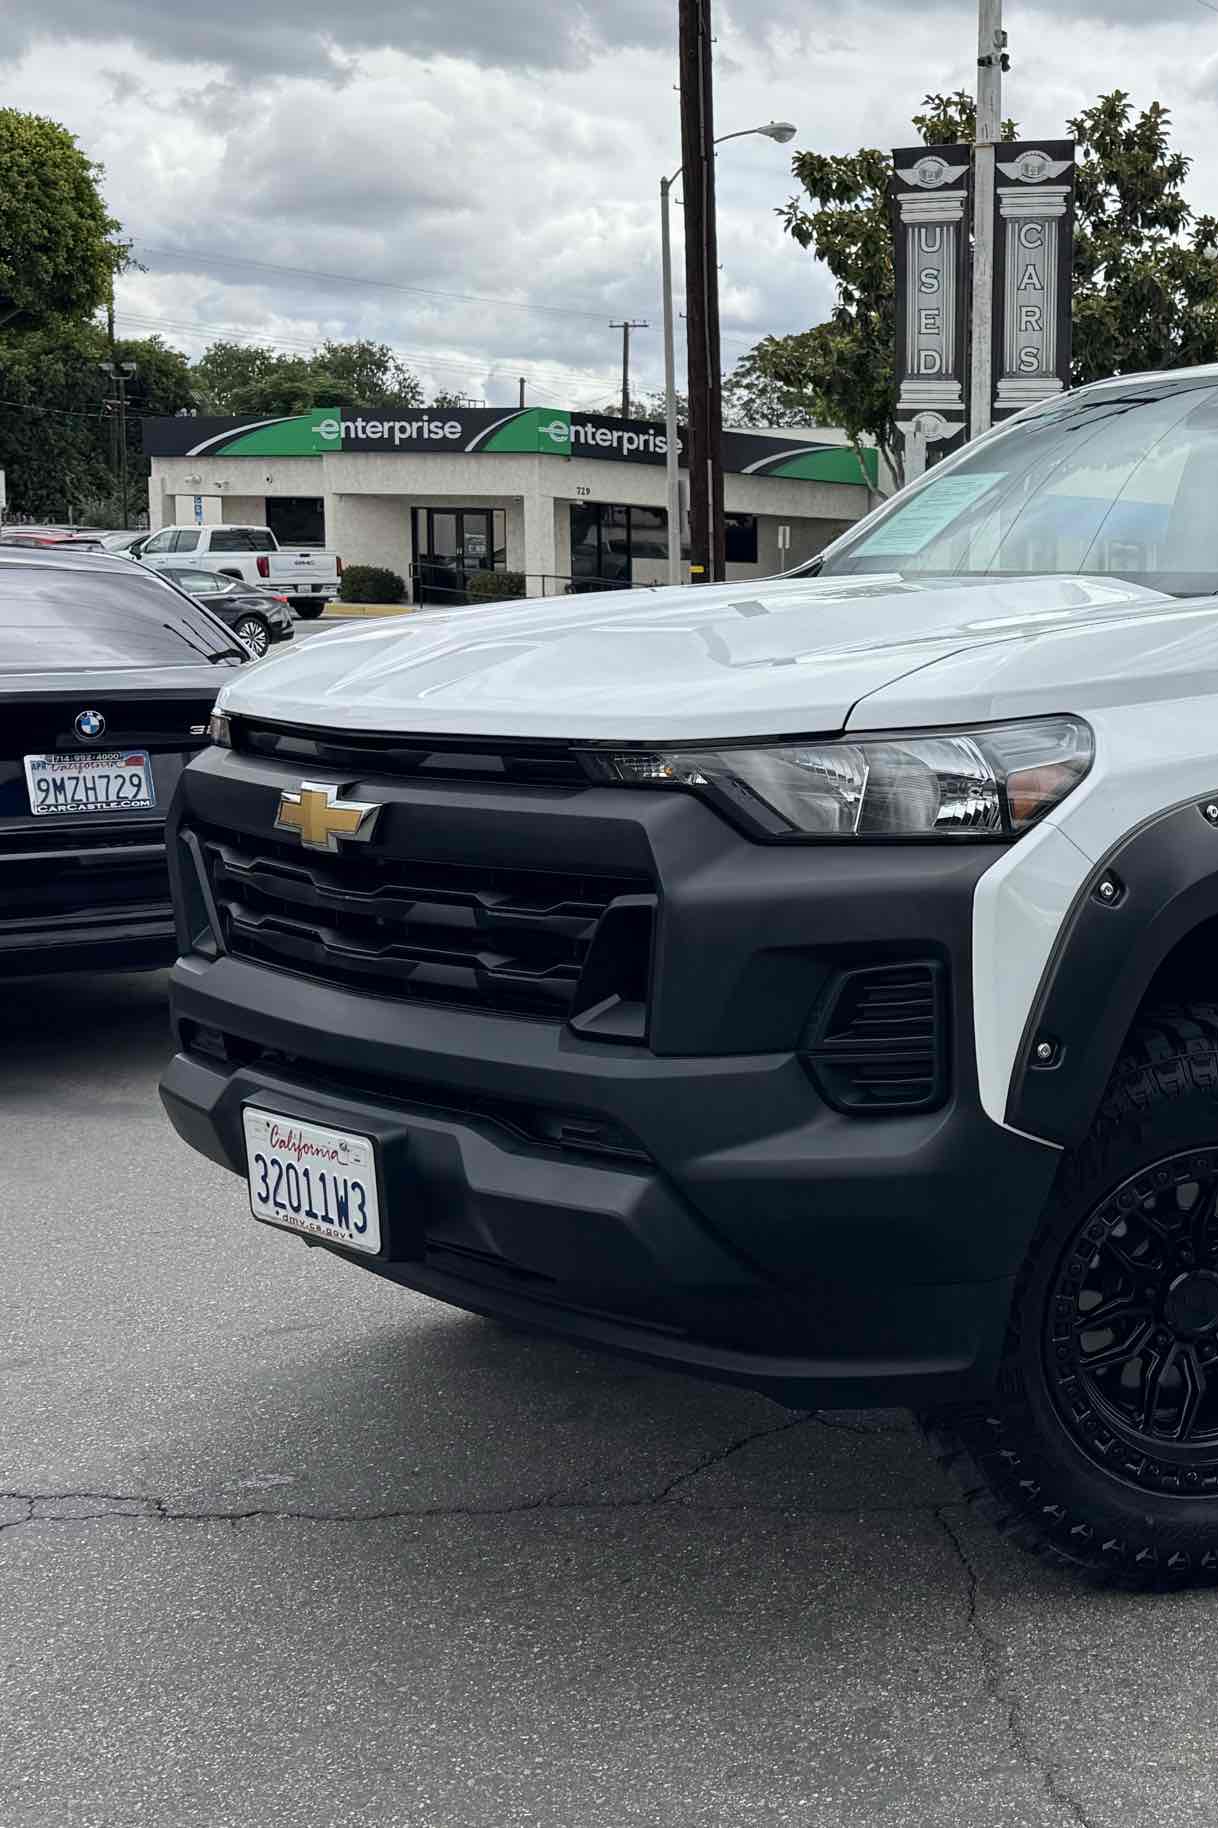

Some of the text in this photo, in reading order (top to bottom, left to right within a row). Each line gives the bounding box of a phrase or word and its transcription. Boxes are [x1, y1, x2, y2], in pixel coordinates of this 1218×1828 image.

[919, 226, 942, 376] USED
[1017, 222, 1045, 375] CARS
[312, 415, 462, 445] enterprise
[576, 486, 591, 496] 729
[190, 725, 211, 735] 3
[36, 773, 143, 805] 9MZH729
[270, 1124, 339, 1162] California
[254, 1153, 368, 1234] 32011W3
[282, 1214, 347, 1239] dmv.ca.gov
